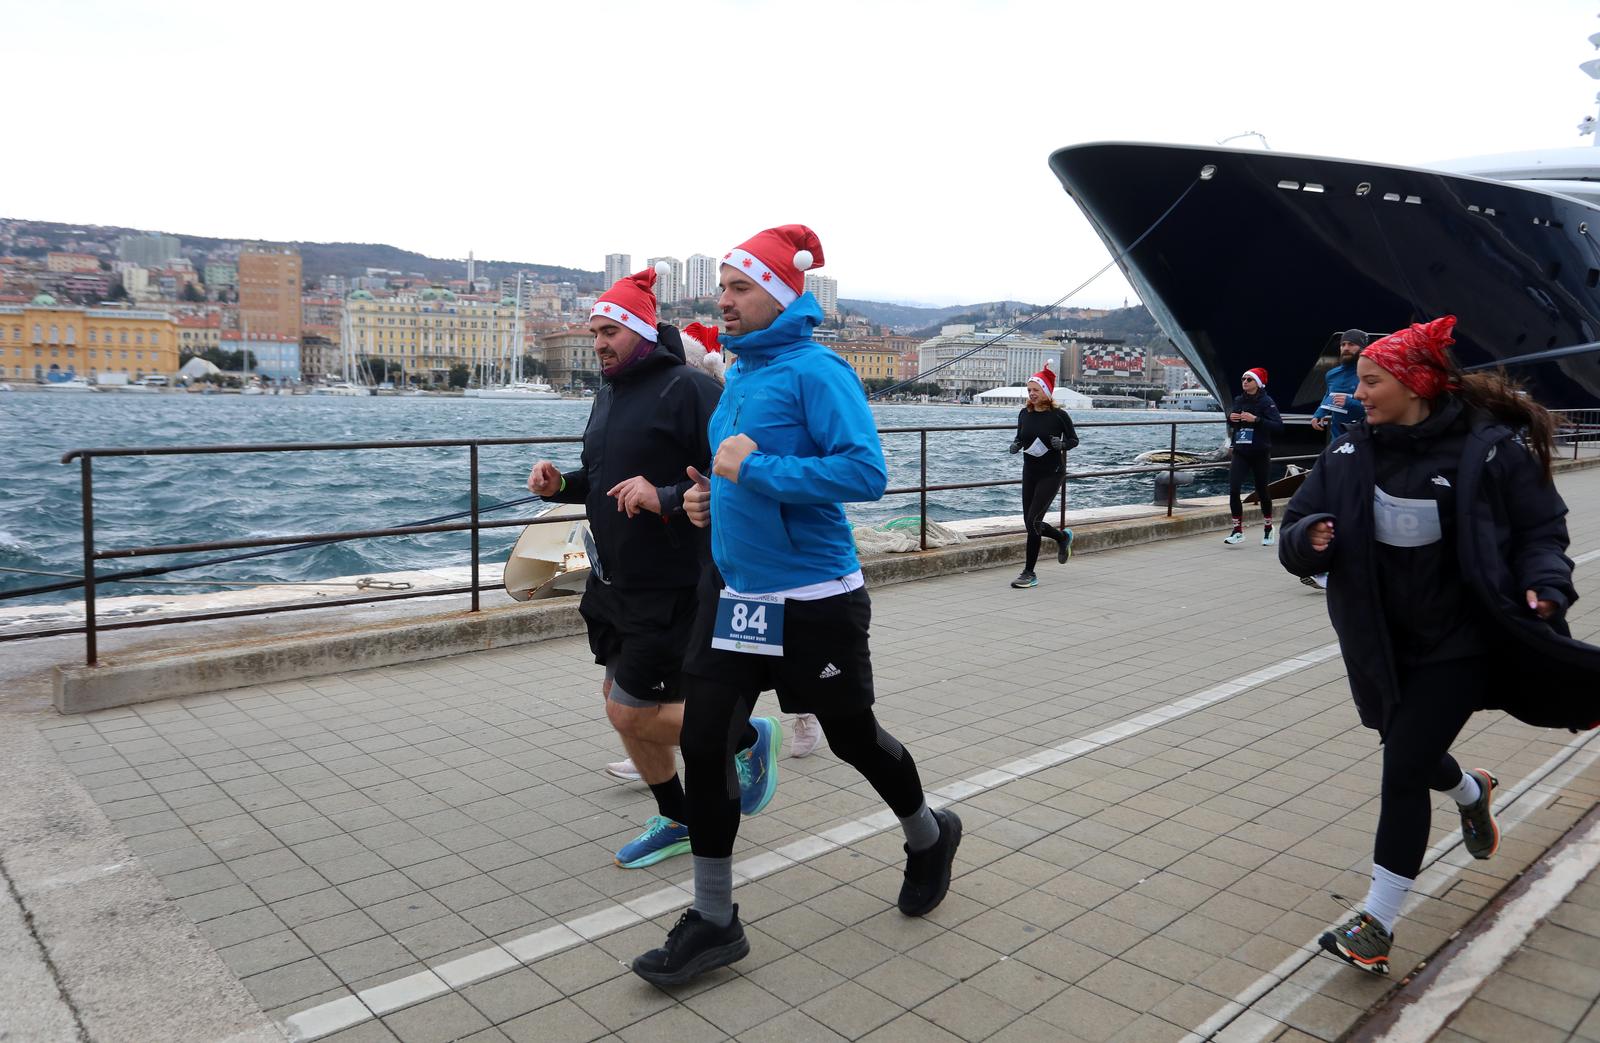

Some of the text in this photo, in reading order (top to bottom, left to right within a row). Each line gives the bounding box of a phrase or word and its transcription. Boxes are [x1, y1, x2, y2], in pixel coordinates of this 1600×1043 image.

[1240, 431, 1246, 439] 2
[731, 603, 768, 635] 84
[819, 668, 841, 679] adidas
